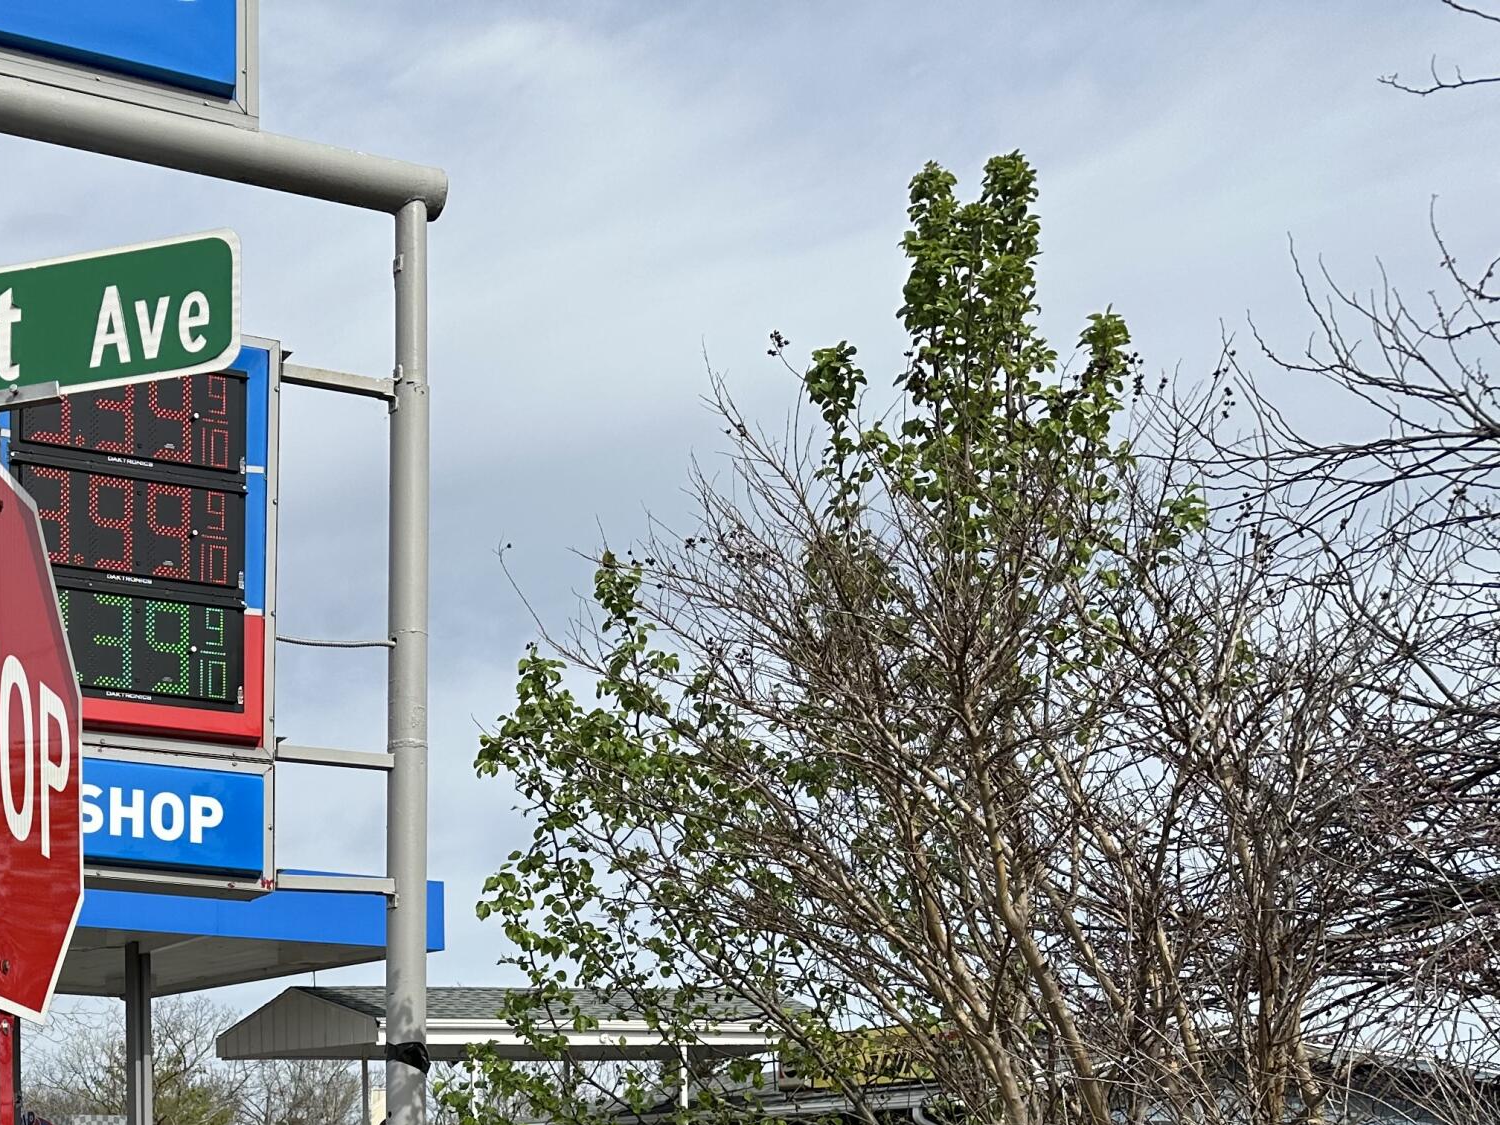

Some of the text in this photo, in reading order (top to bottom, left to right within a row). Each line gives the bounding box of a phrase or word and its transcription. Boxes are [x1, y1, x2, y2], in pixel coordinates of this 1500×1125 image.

[89, 284, 211, 368] Ave
[107, 456, 154, 467] DAKTRONICS
[106, 573, 153, 584] DAKTRONICS
[105, 690, 152, 701] DAKTRONICS
[83, 784, 224, 844] SHOP
